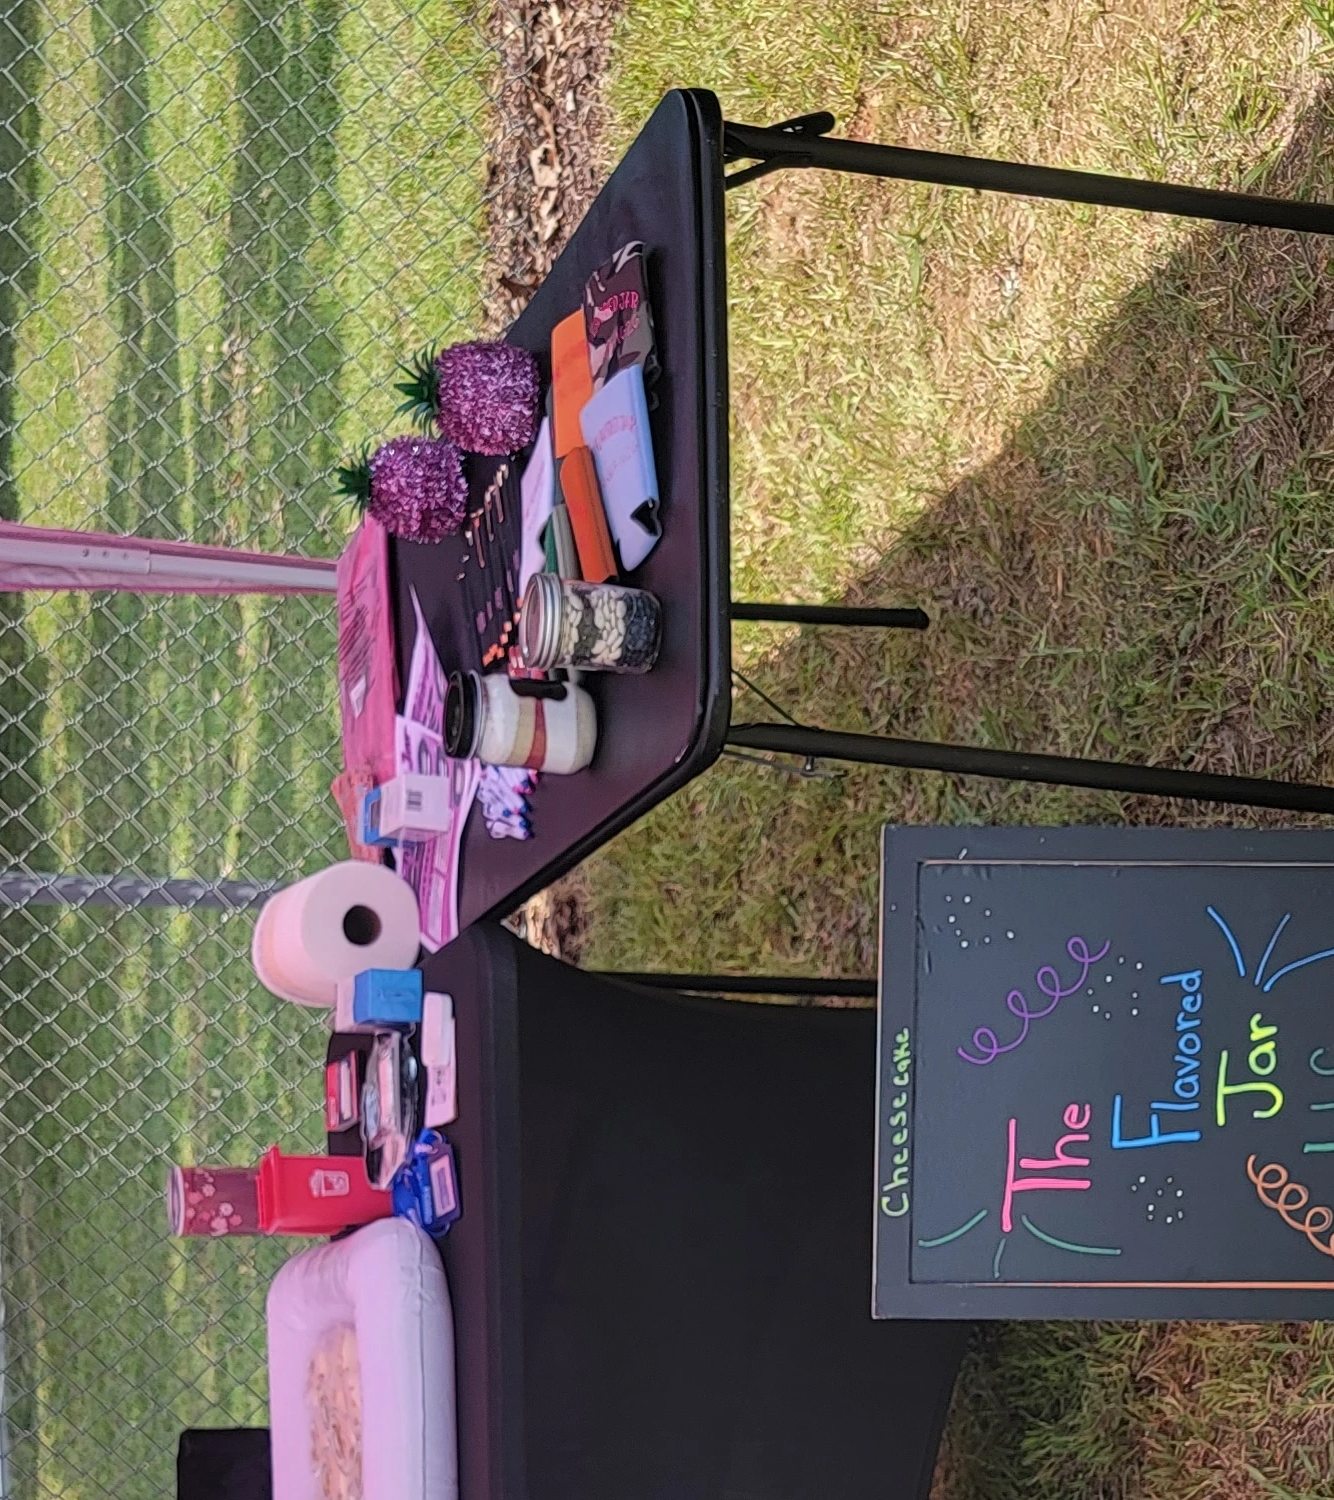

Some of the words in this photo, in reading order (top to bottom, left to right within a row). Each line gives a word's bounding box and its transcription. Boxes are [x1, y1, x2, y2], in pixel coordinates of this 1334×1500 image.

[1110, 969, 1203, 1151] Flavored
[1216, 1013, 1284, 1127] Jar
[1001, 1103, 1091, 1232] The
